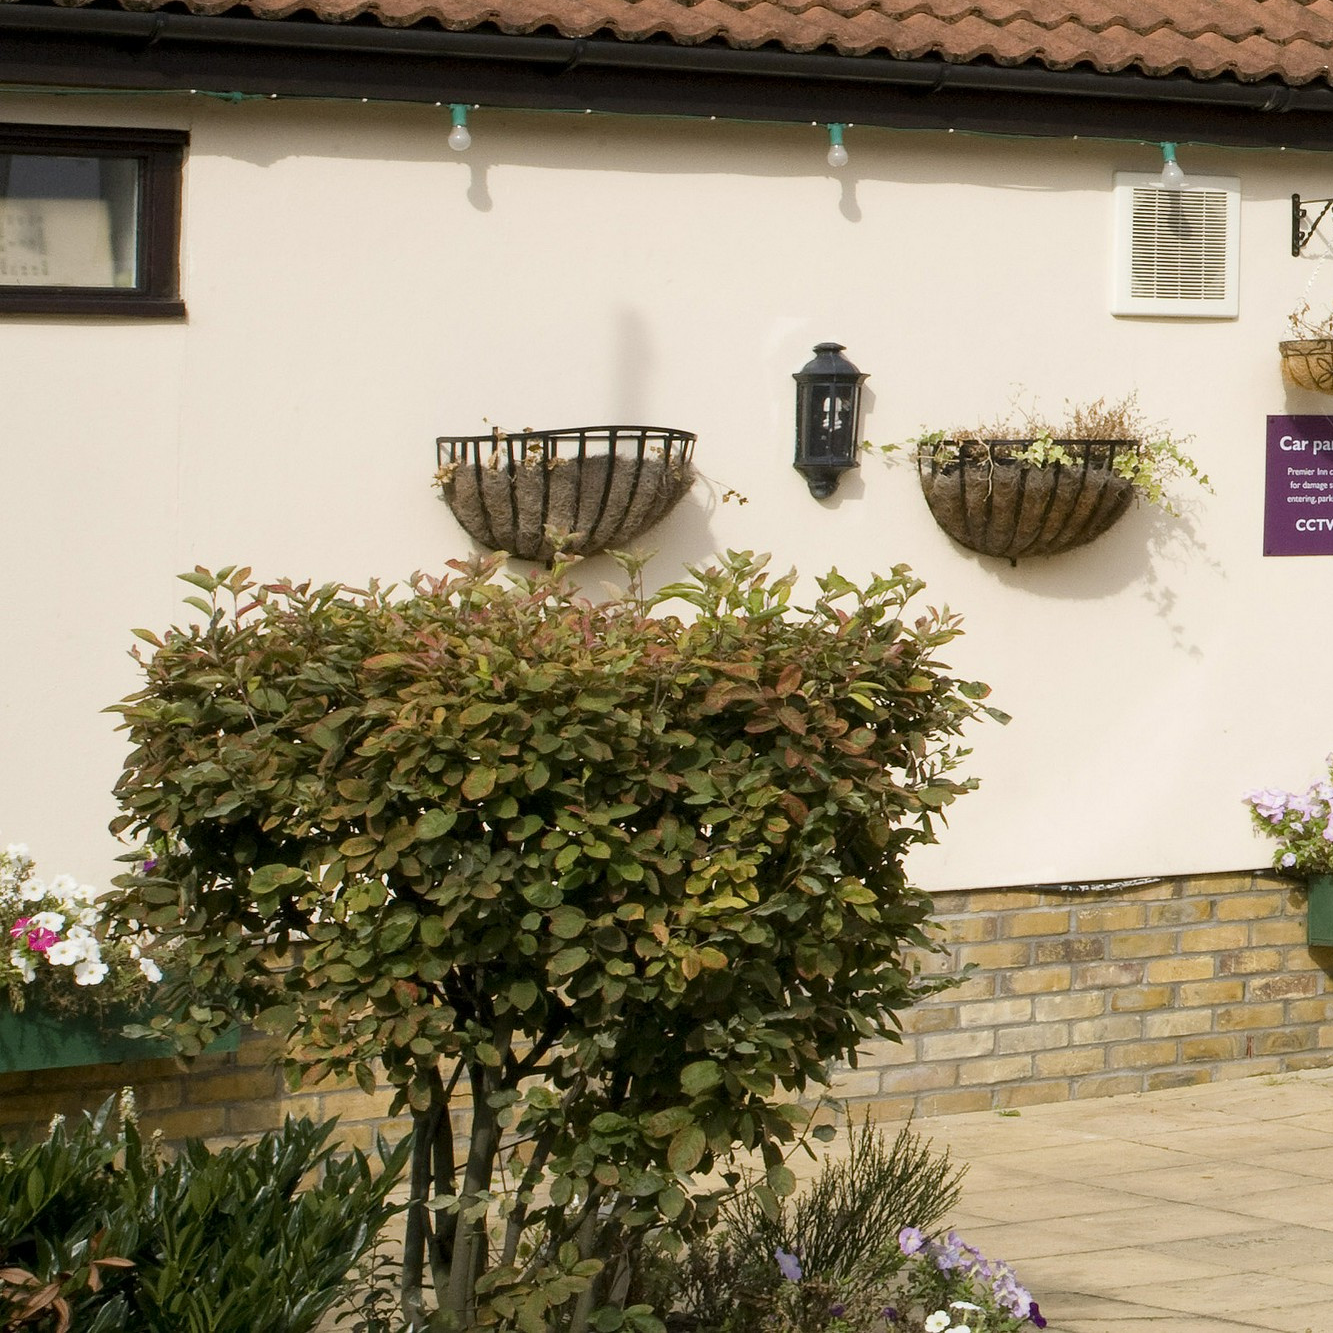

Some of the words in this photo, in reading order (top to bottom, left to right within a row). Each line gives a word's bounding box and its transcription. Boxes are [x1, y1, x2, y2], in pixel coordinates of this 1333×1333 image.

[1279, 436, 1308, 451] Car
[1287, 467, 1315, 476] Premier
[1317, 467, 1328, 476] Inn
[1290, 480, 1301, 489] for
[1302, 480, 1328, 491] damage
[1287, 494, 1317, 505] entering,
